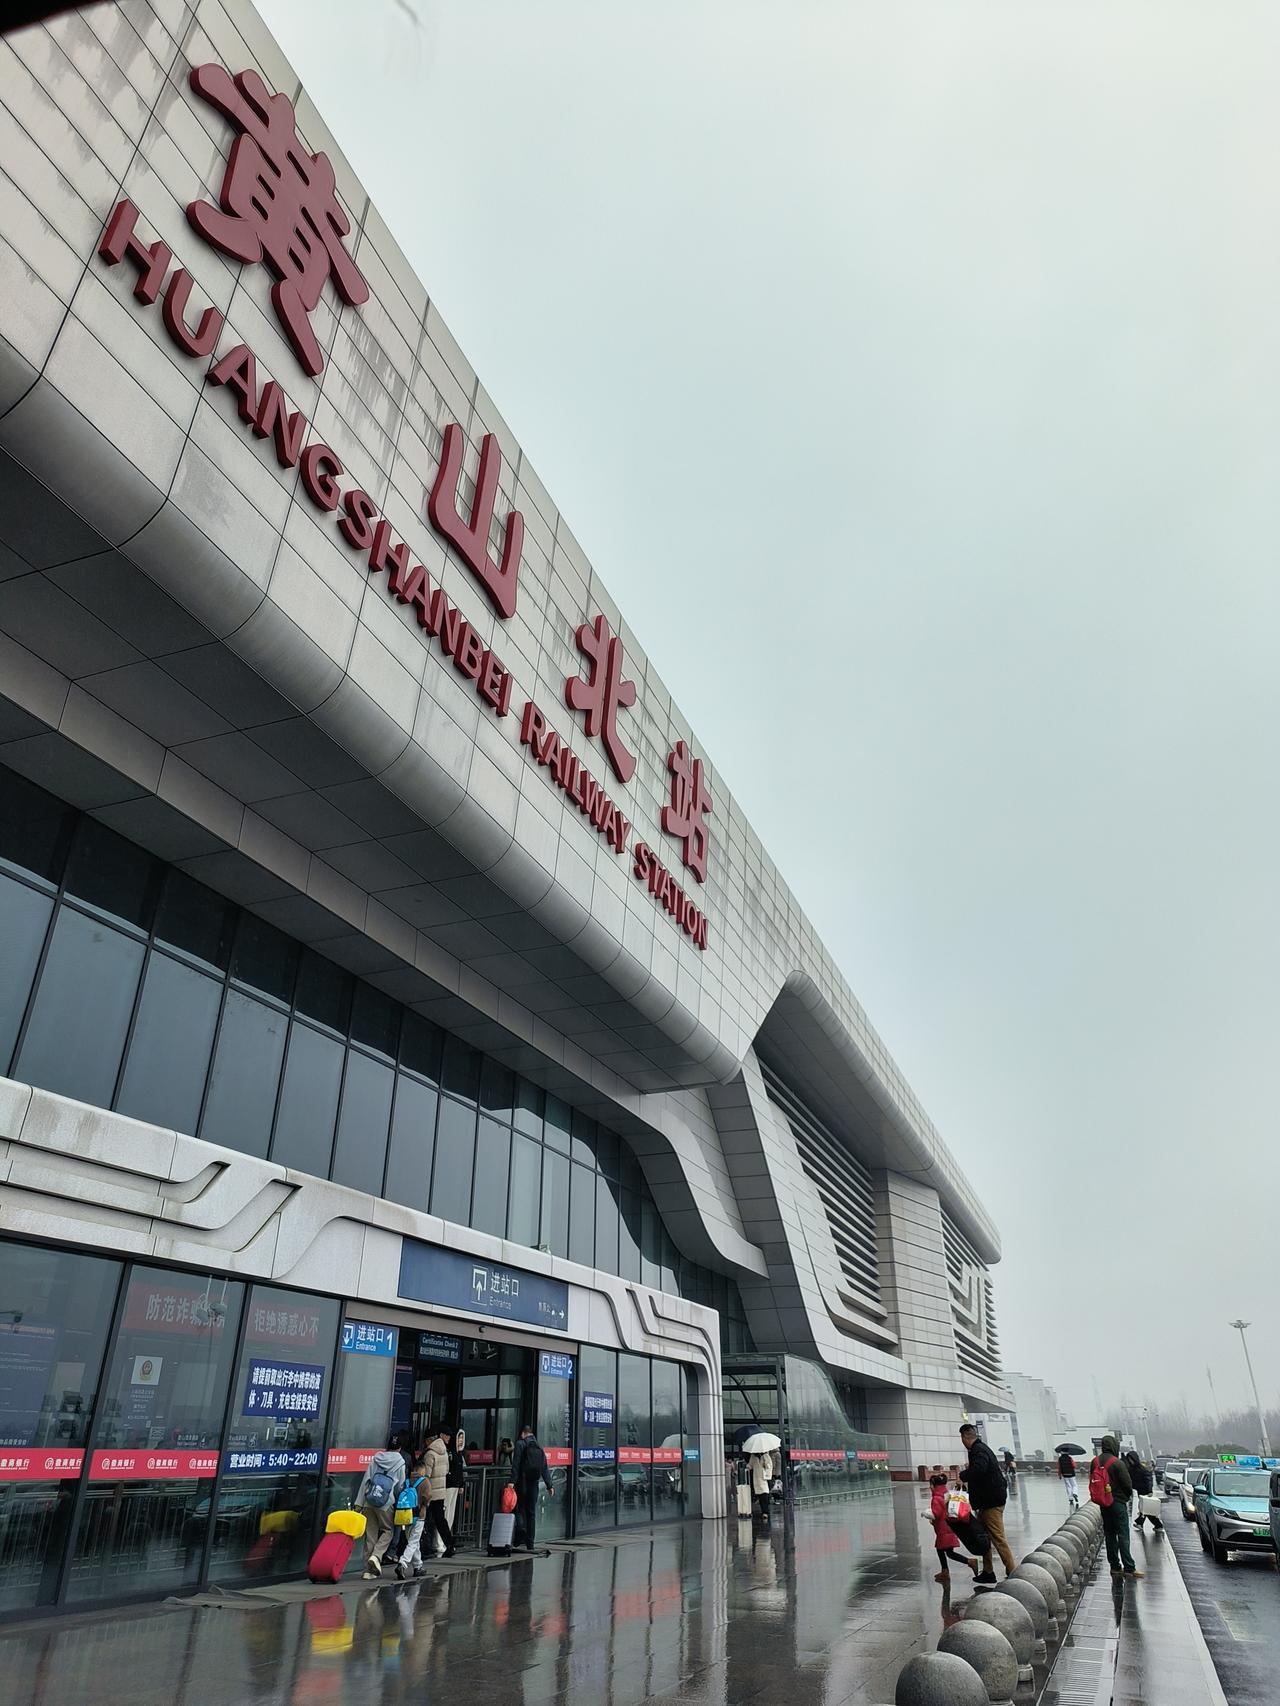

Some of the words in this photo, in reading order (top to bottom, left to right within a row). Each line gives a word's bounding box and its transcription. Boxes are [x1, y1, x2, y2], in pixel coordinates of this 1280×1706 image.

[98, 199, 512, 718] HUANGSHANBEI
[519, 701, 633, 855] RAILWAY
[633, 842, 708, 951] STATION
[491, 1271, 520, 1297] 进站口
[355, 1341, 377, 1352] Entrance
[357, 1325, 385, 1343] 进站口
[386, 1332, 393, 1351] 1
